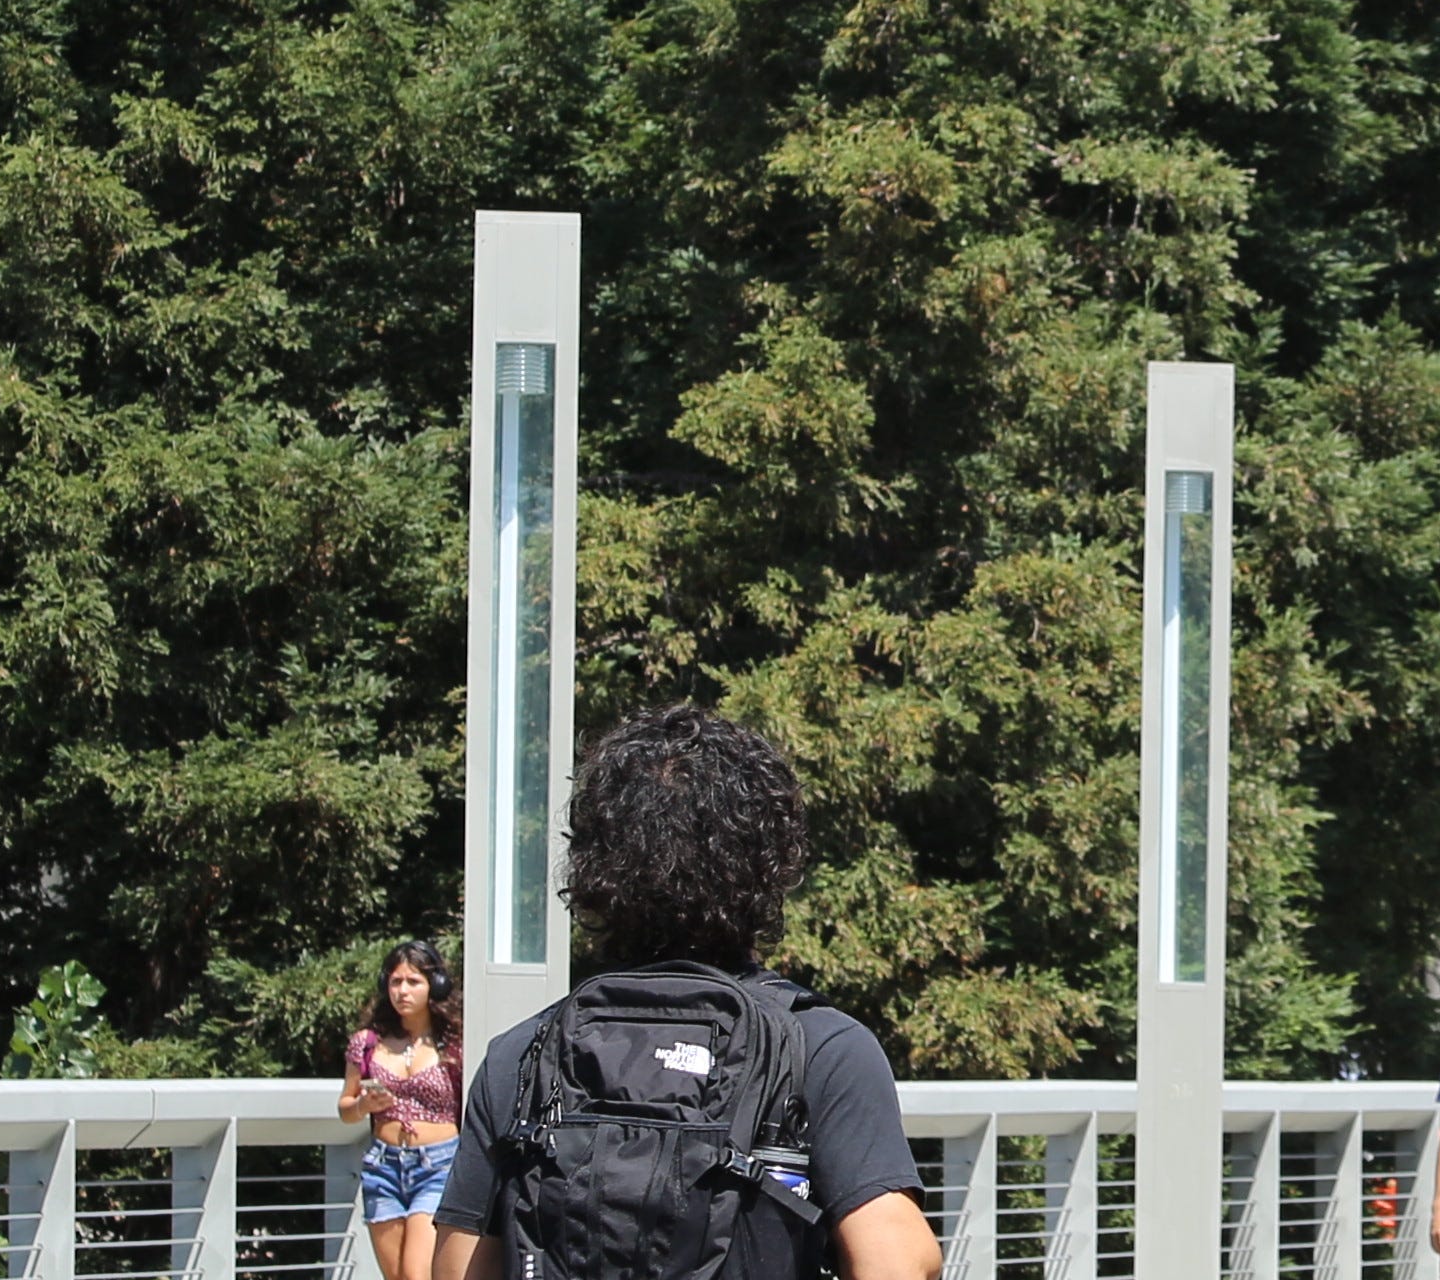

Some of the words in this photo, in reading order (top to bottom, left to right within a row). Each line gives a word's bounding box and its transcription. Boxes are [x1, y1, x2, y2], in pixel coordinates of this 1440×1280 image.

[674, 1042, 697, 1055] THE
[655, 1048, 697, 1065] NORTH
[664, 1059, 697, 1072] FACE
